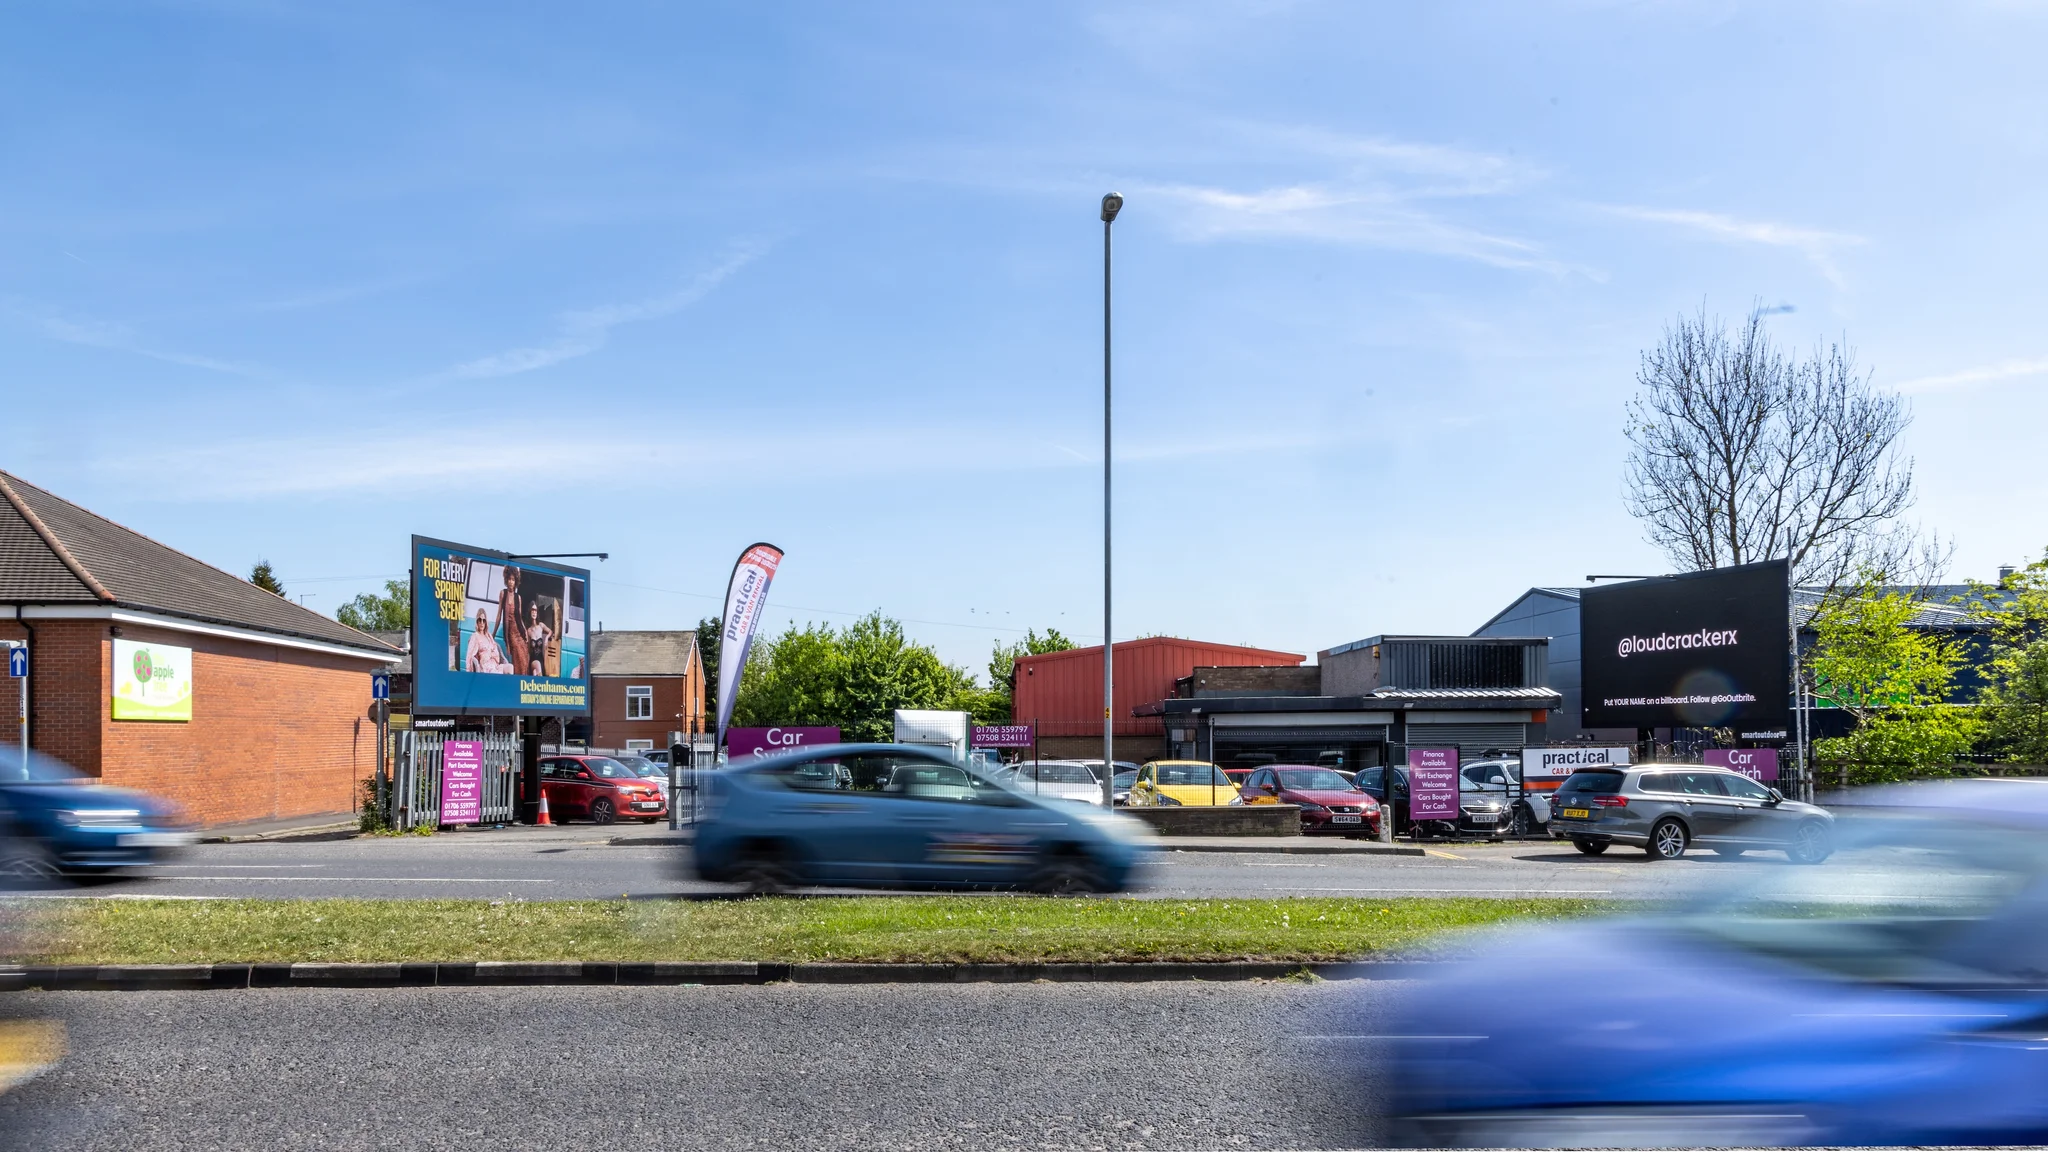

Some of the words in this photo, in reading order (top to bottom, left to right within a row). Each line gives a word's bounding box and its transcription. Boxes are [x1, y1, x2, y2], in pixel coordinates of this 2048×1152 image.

[423, 557, 440, 579] FOR
[440, 560, 466, 583] EVERY
[435, 579, 465, 602] SPRING
[439, 600, 466, 621] SCENE
[726, 569, 757, 642] practical
[740, 622, 748, 634] CAR
[752, 575, 765, 599] RENTAL
[1618, 628, 1738, 658] @loudcrackerx
[153, 664, 175, 681] apple
[520, 679, 585, 694] Debenhams.com
[1604, 698, 1614, 706] Put
[1614, 698, 1629, 706] YOUR
[1629, 697, 1646, 705] NAME
[1660, 695, 1689, 705] billboard.
[1690, 695, 1710, 703] Follow
[415, 718, 449, 727] smartoutdoor
[1001, 725, 1028, 733] 559797
[766, 727, 803, 745] Car
[1741, 730, 1780, 739] smartoutdoor
[1542, 748, 1609, 768] practical
[1728, 750, 1753, 764] Car
[457, 762, 478, 770] Exchange
[1565, 767, 1571, 775] &
[460, 782, 476, 790] Bought
[444, 802, 459, 810] 01706
